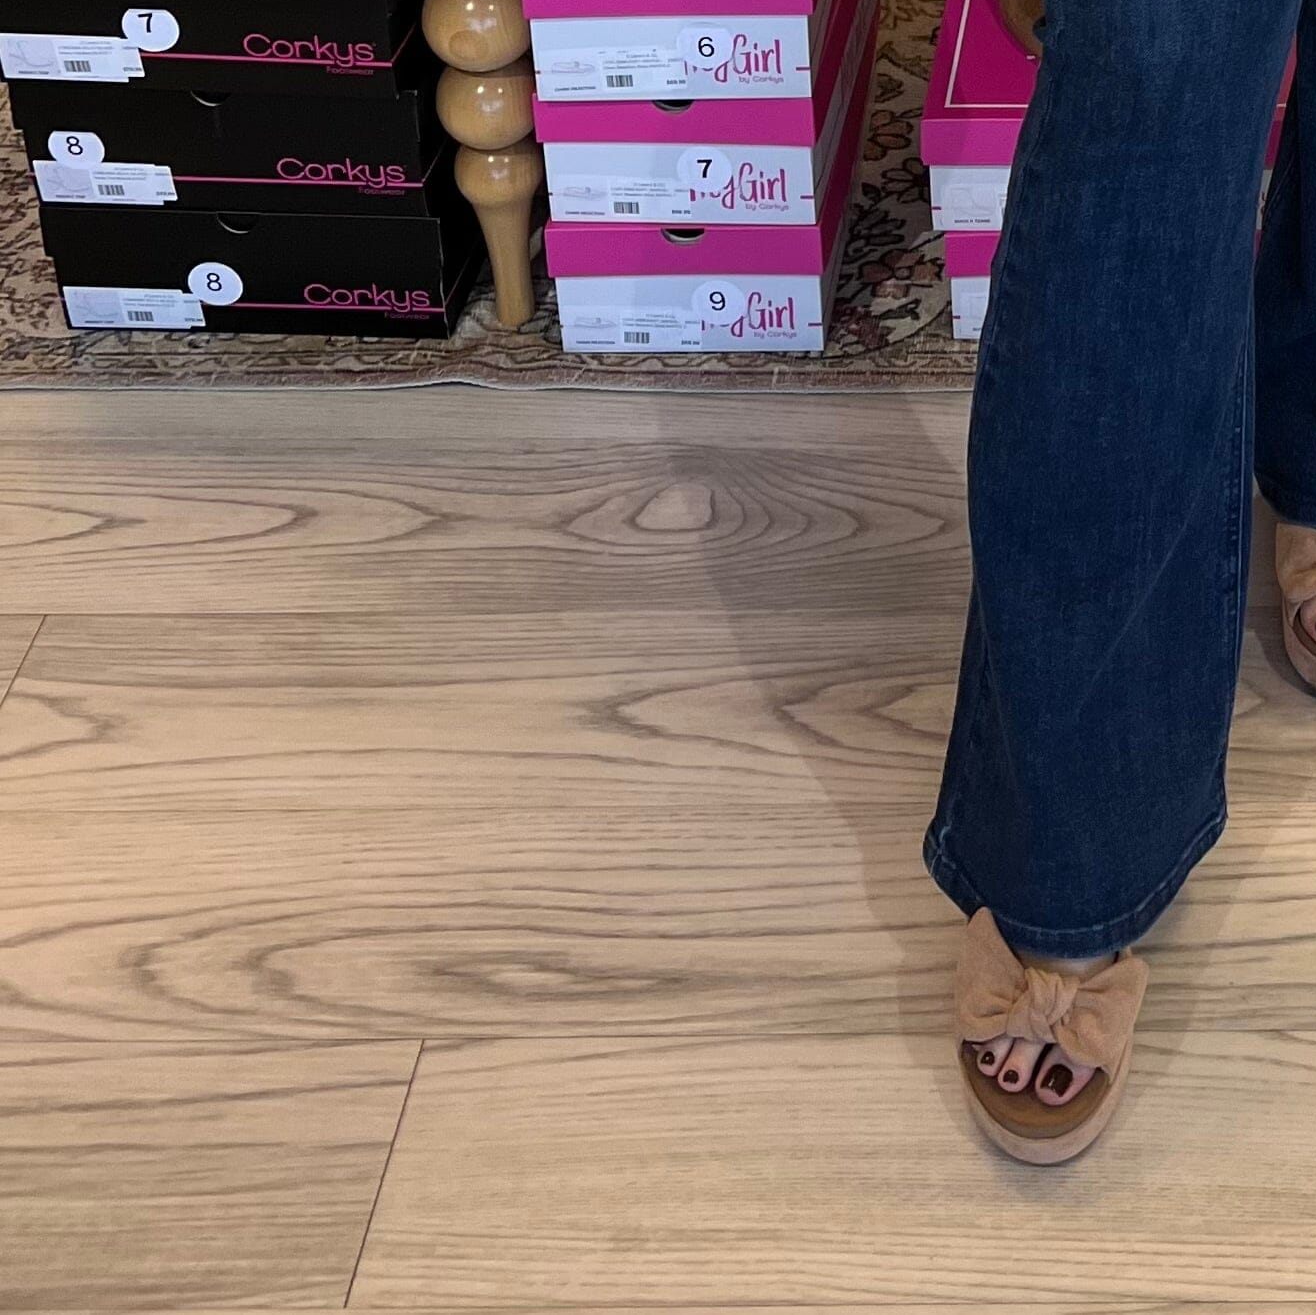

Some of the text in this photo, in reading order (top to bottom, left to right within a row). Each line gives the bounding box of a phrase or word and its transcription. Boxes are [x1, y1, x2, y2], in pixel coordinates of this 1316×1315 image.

[138, 12, 153, 33] 7
[243, 33, 375, 66] Corkys
[697, 36, 715, 57] 6
[752, 75, 784, 84] Corkys
[65, 136, 84, 156] 8
[276, 157, 406, 188] Corkys
[696, 159, 713, 178] 7
[758, 203, 789, 211] Corkys
[206, 272, 223, 291] 8
[304, 283, 431, 313] Corkys
[708, 291, 726, 311] 9
[766, 331, 797, 339] Corkys
